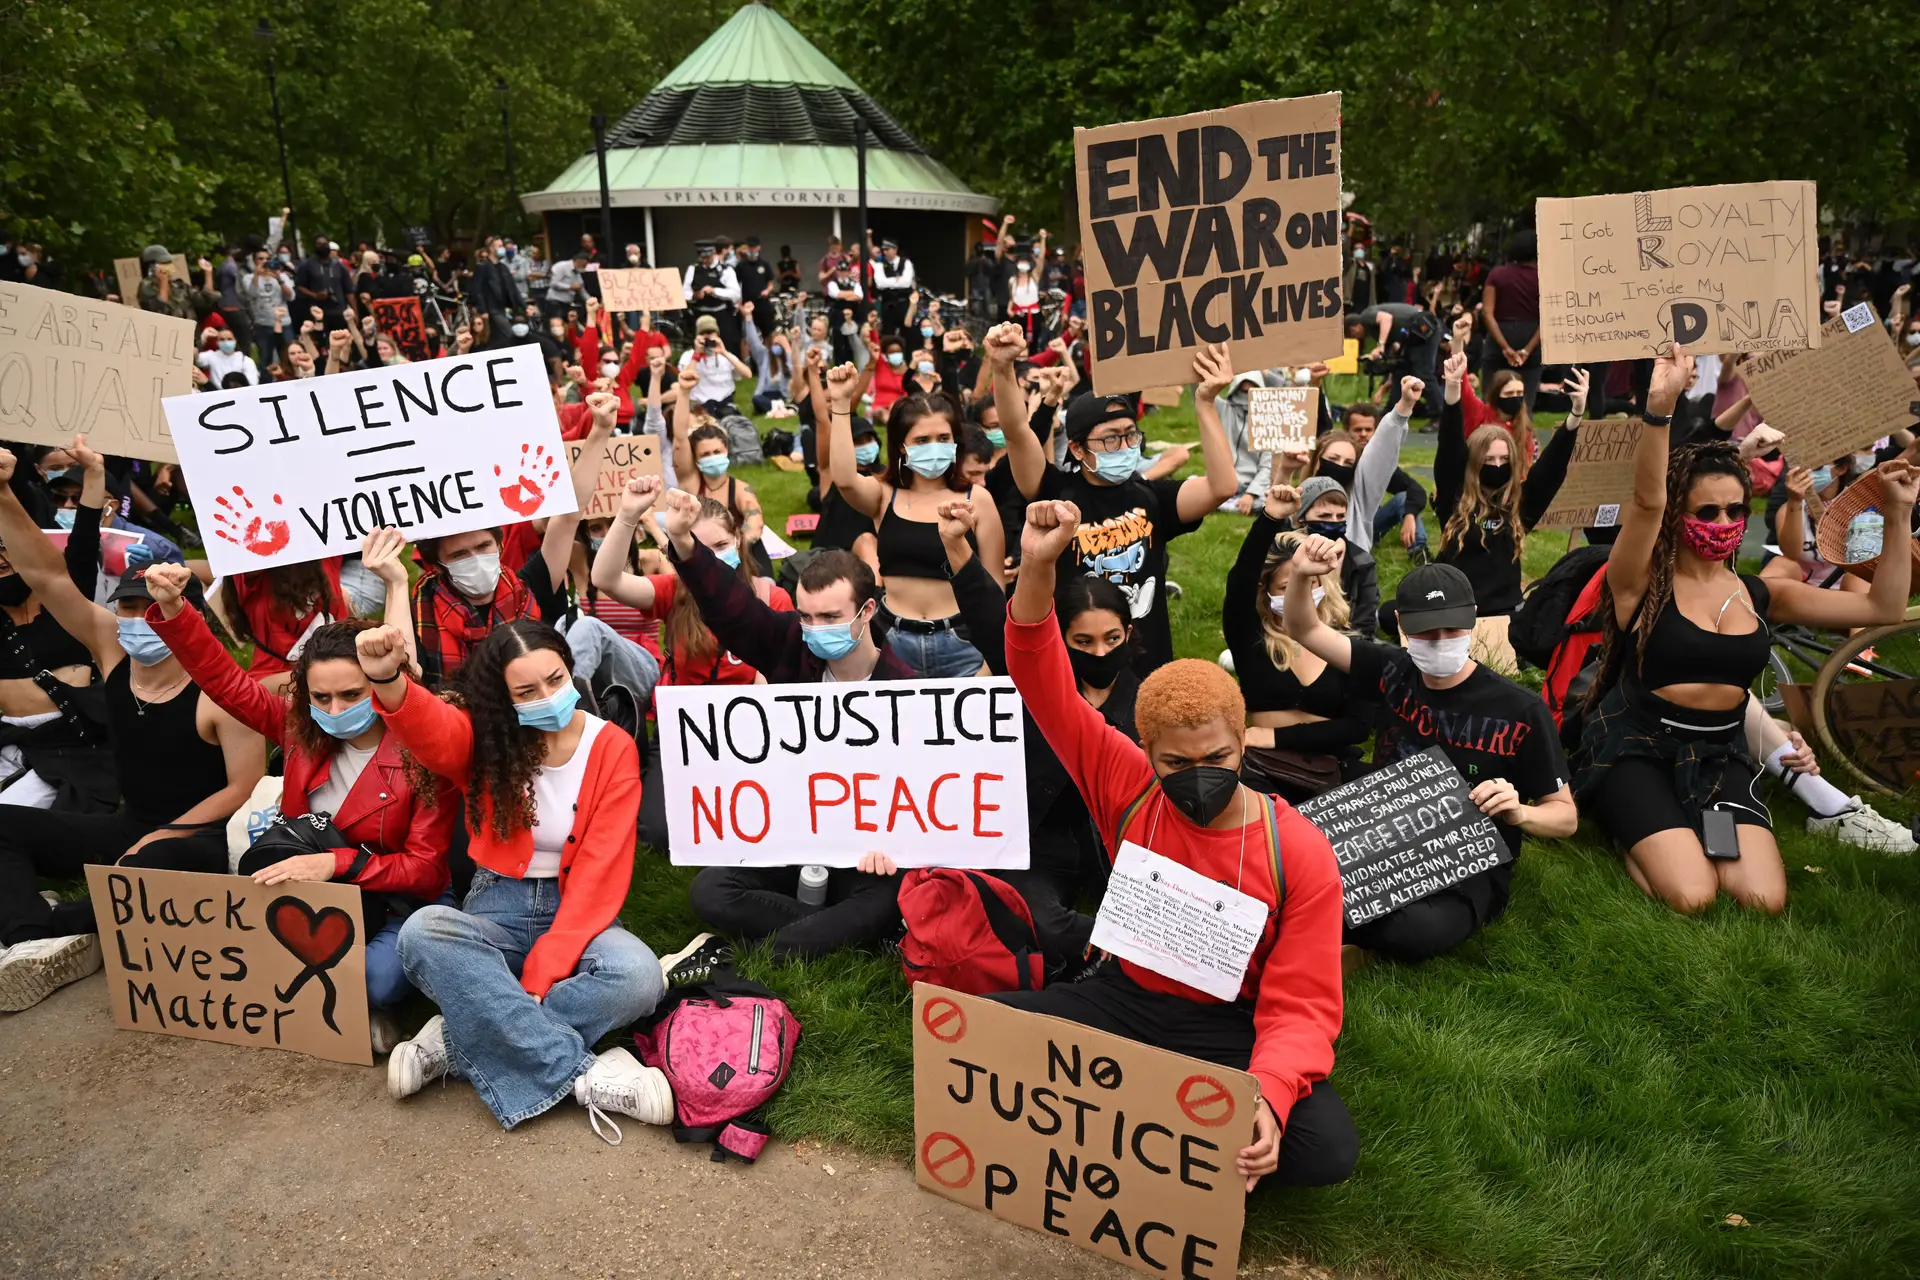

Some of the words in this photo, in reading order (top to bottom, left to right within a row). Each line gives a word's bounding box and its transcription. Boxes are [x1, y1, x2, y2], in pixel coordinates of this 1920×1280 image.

[771, 192, 846, 203] CORNER
[1087, 125, 1252, 219] END
[1257, 131, 1336, 181] THE
[1091, 197, 1288, 288] WAR
[1285, 210, 1337, 249] ON
[1559, 223, 1573, 240] I
[1582, 222, 1614, 239] Got
[1635, 194, 1799, 232] LOYALTY
[1582, 256, 1616, 275] Got
[1637, 234, 1804, 271] ROYALTY
[1092, 271, 1265, 362] BLACK
[1262, 277, 1341, 325] LIVES
[1545, 290, 1602, 308] #BLM
[1548, 311, 1626, 328] #ENOUGH
[1620, 281, 1684, 300] Inside
[1697, 278, 1724, 303] My
[0, 292, 18, 335] E
[26, 301, 107, 351] ARE
[112, 318, 183, 366] ALL
[1670, 298, 1809, 345] DNA
[0, 352, 175, 447] QUAL
[198, 357, 525, 455] SILENCE
[1289, 424, 1303, 438] IT
[1584, 424, 1608, 444] UK
[1608, 424, 1621, 442] IS
[1622, 423, 1643, 441] NO
[299, 470, 485, 546] VIOLENCE
[678, 696, 770, 766] NO
[774, 686, 1018, 755] JUSTICE
[692, 779, 771, 844] NO
[808, 771, 1004, 838] PEACE
[1297, 800, 1318, 816] RIC
[1317, 782, 1365, 808] GARNER,
[1363, 768, 1397, 790] EZELL
[1396, 752, 1433, 773] FORD,
[1334, 814, 1375, 834] HALL,
[1370, 792, 1421, 819] SANDRA
[1420, 777, 1460, 801] BLAND
[1337, 789, 1388, 816] PARKER,
[1384, 776, 1413, 799] PAUL
[1333, 823, 1399, 867] EORGE
[1393, 795, 1464, 842] FLOYD
[1342, 865, 1370, 889] AVID
[1422, 830, 1461, 855] TAMIR
[1460, 816, 1498, 840] RICE,
[1456, 836, 1496, 859] FRED
[108, 874, 257, 931] Black
[1111, 869, 1128, 880] Sarah
[1144, 883, 1160, 894] Mark
[1183, 902, 1202, 914] Jimmy
[1232, 923, 1257, 938] Michael
[1129, 883, 1144, 894] Leon
[1163, 899, 1180, 911] Ricky
[1201, 917, 1218, 928] Brian
[1243, 936, 1254, 944] Joy
[1133, 892, 1147, 903] Sean
[1161, 906, 1177, 916] Leon
[1205, 926, 1229, 941] Cynthia
[1349, 902, 1391, 925] BLUE,
[1389, 879, 1446, 907] ALTERIA
[1442, 853, 1500, 884] WOODS
[1100, 905, 1125, 920] Demetre
[1144, 926, 1161, 937] Aston
[1183, 944, 1197, 953] Seni
[1216, 958, 1242, 973] Anthony
[1105, 887, 1125, 900] Cherry
[1143, 904, 1161, 916] Derek
[1183, 923, 1208, 939] Kingsley
[1231, 944, 1249, 956] Roger
[1114, 904, 1133, 917] Adrian
[1163, 928, 1177, 938] Jean
[1122, 922, 1140, 935] Rocky
[1163, 941, 1179, 952] Mark
[1133, 934, 1144, 943] The
[1144, 940, 1154, 948] UK
[1135, 908, 1153, 919] Azelle
[1175, 926, 1194, 938] Habib
[1211, 943, 1229, 954] Faruk
[115, 929, 248, 981] Lives
[127, 979, 295, 1044] Matter
[947, 1057, 1221, 1191] JUSTICE
[984, 1163, 1218, 1280] PEACE
